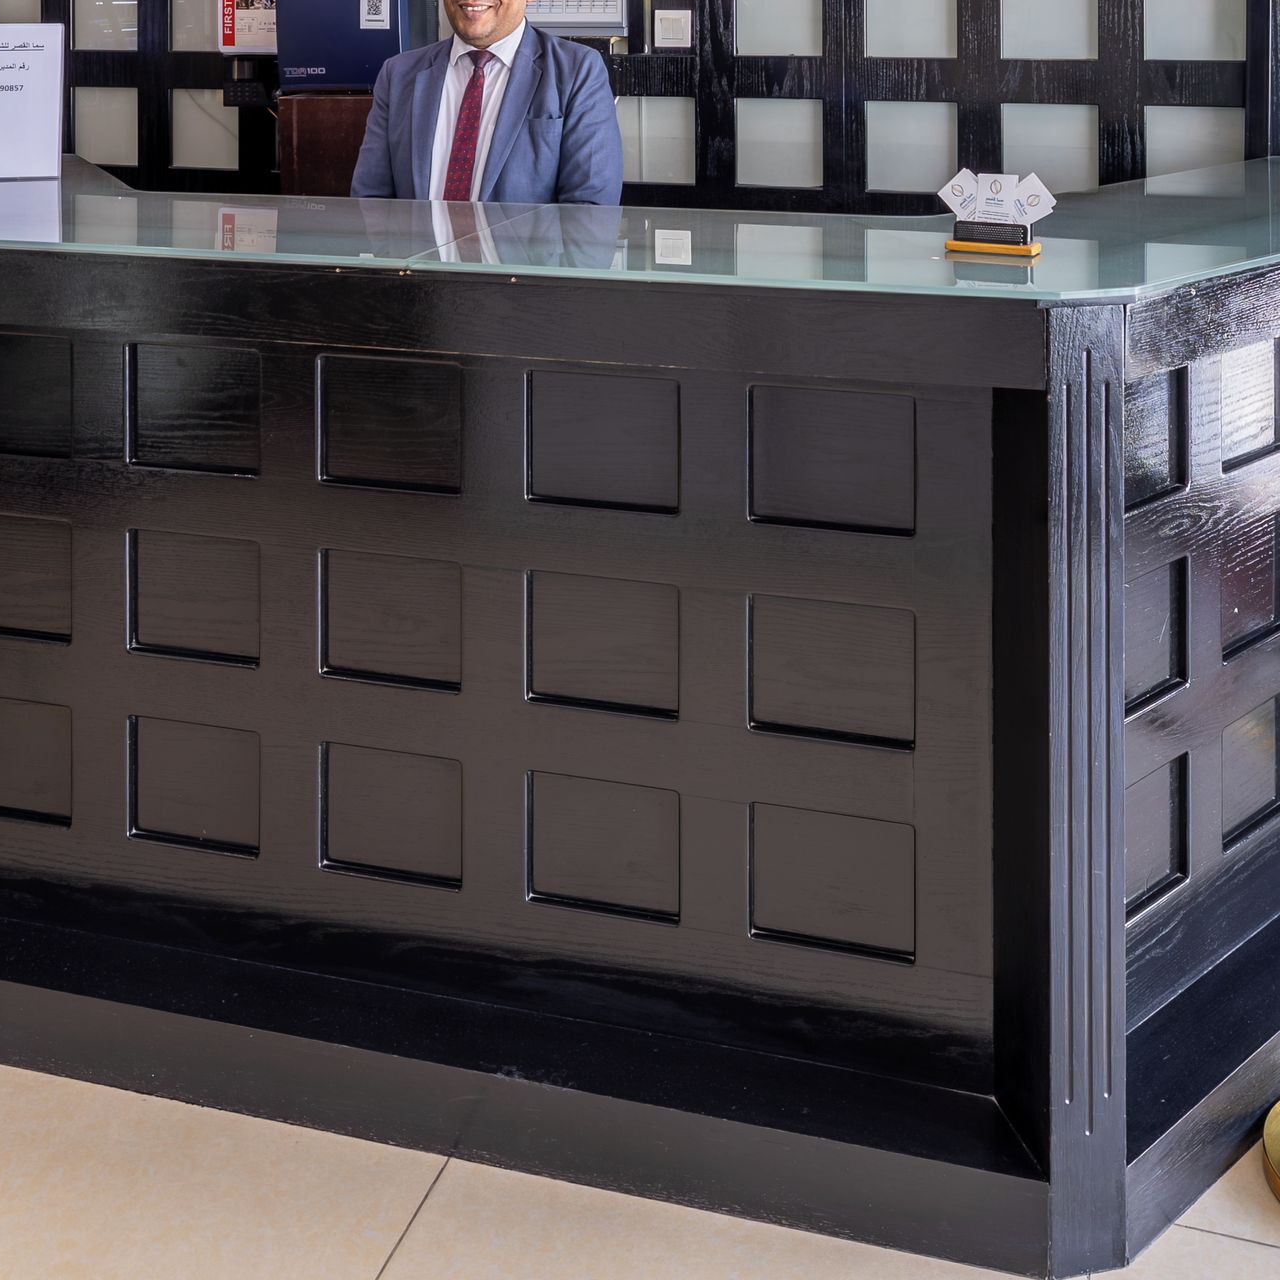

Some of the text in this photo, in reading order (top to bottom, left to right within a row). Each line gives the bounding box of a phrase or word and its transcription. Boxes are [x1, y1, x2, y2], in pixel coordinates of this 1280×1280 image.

[224, 0, 232, 34] FIRST
[12, 42, 30, 50] القصر
[18, 62, 30, 71] رقم
